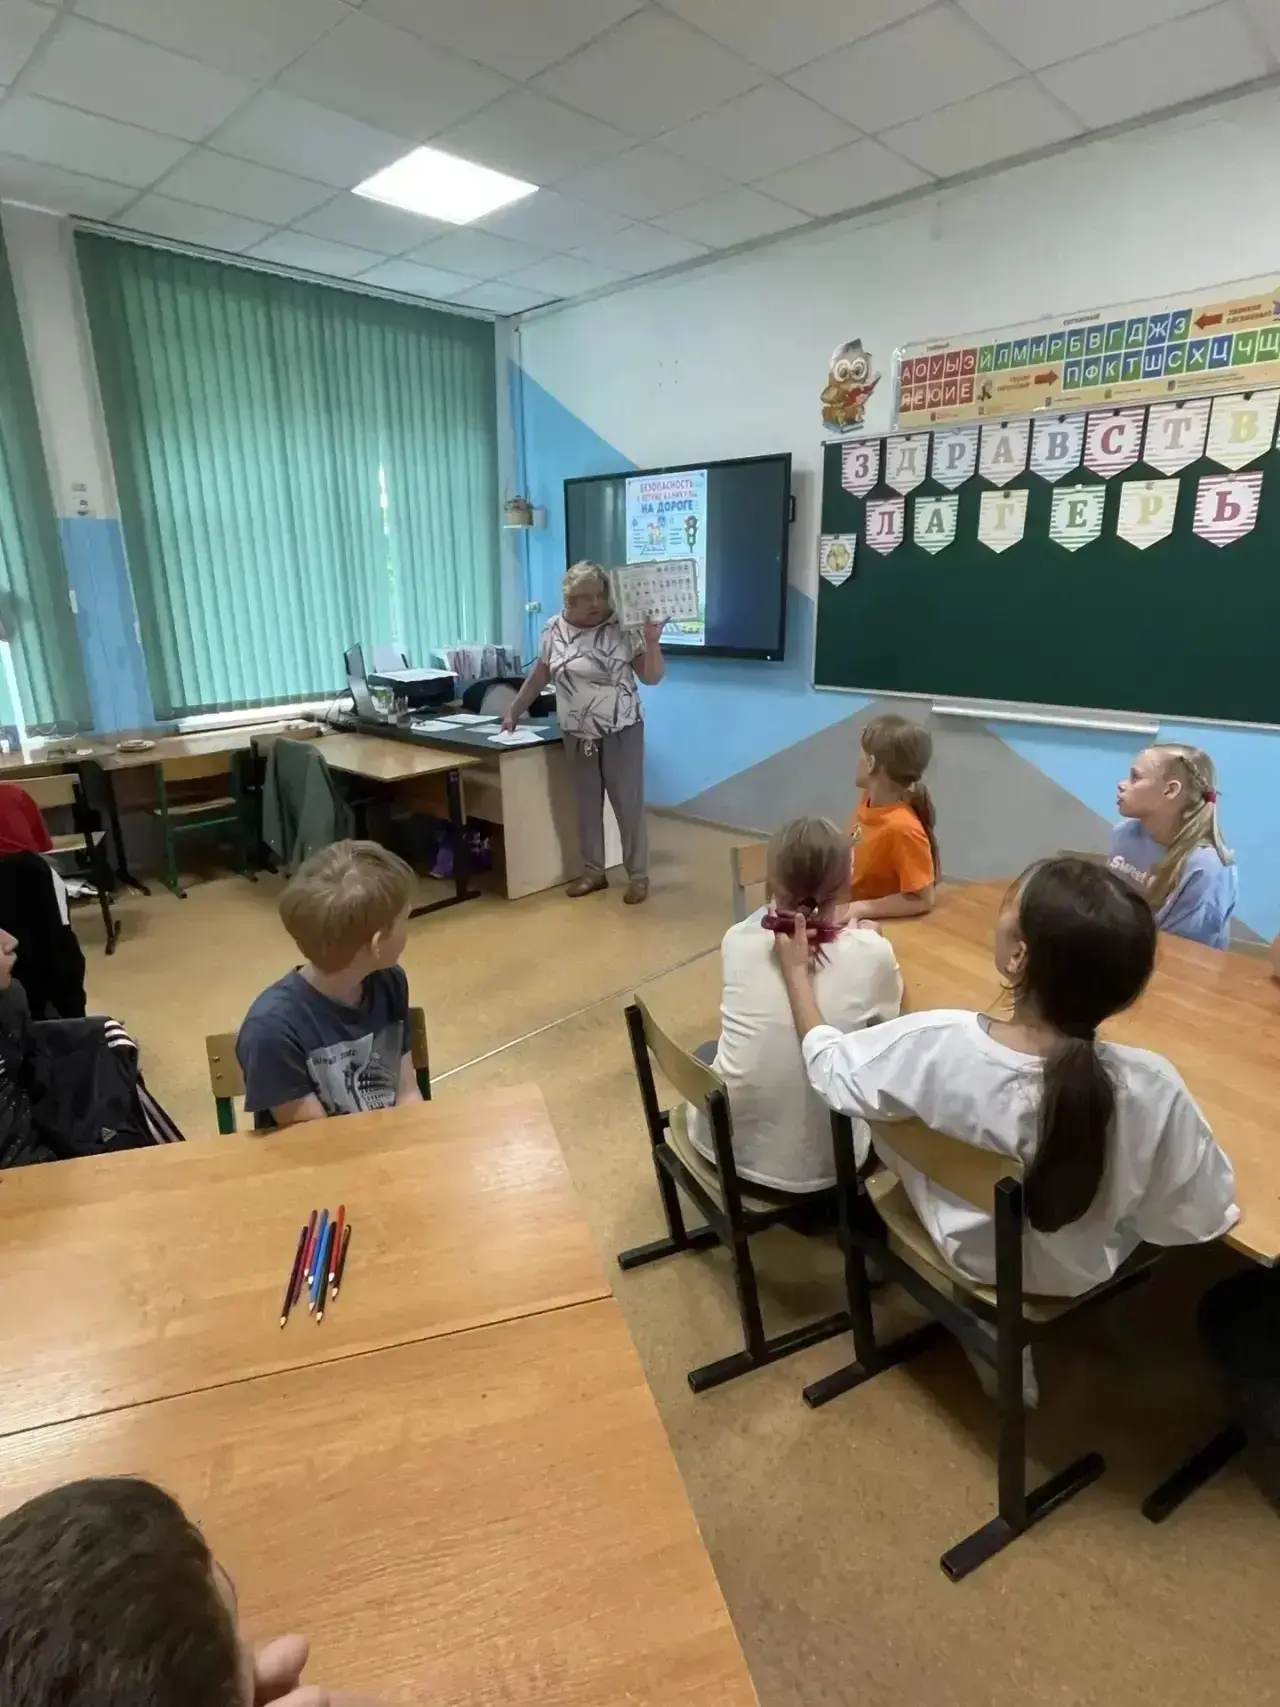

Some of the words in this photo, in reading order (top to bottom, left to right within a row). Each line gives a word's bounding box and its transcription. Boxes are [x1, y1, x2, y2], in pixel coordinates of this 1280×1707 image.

[902, 366, 912, 380] А
[915, 363, 927, 377] О
[932, 362, 943, 375] У
[946, 358, 959, 372] Ы
[963, 355, 975, 369] Э
[980, 352, 992, 369] Й
[997, 349, 1008, 364] Л
[1013, 347, 1027, 361] М
[1031, 343, 1043, 358] Н
[1050, 340, 1062, 355] Р
[1070, 336, 1081, 352] Б
[1089, 334, 1101, 348] В
[1109, 329, 1121, 345] Г
[1128, 324, 1143, 342] Д
[1148, 320, 1168, 338] Ж
[1174, 317, 1185, 334] З
[1067, 367, 1079, 382] П
[1085, 365, 1098, 379] Ф
[1106, 360, 1116, 377] К
[1127, 357, 1140, 372] Т
[1144, 354, 1162, 371] Ш
[1168, 351, 1182, 367] С
[1190, 348, 1205, 364] Х
[1213, 341, 1228, 361] Ц
[1238, 339, 1252, 356] Ч
[1259, 333, 1280, 353] Щ
[928, 388, 941, 402] Ю
[945, 386, 956, 400] И
[962, 383, 971, 397] Е
[640, 480, 693, 493] БЕЗОПАСНОСТЬ
[641, 503, 653, 513] НА
[657, 500, 693, 513] ДОРОГЕ
[876, 491, 1242, 535] ЛАГЕРЬ
[1109, 855, 1147, 883] Sweet
